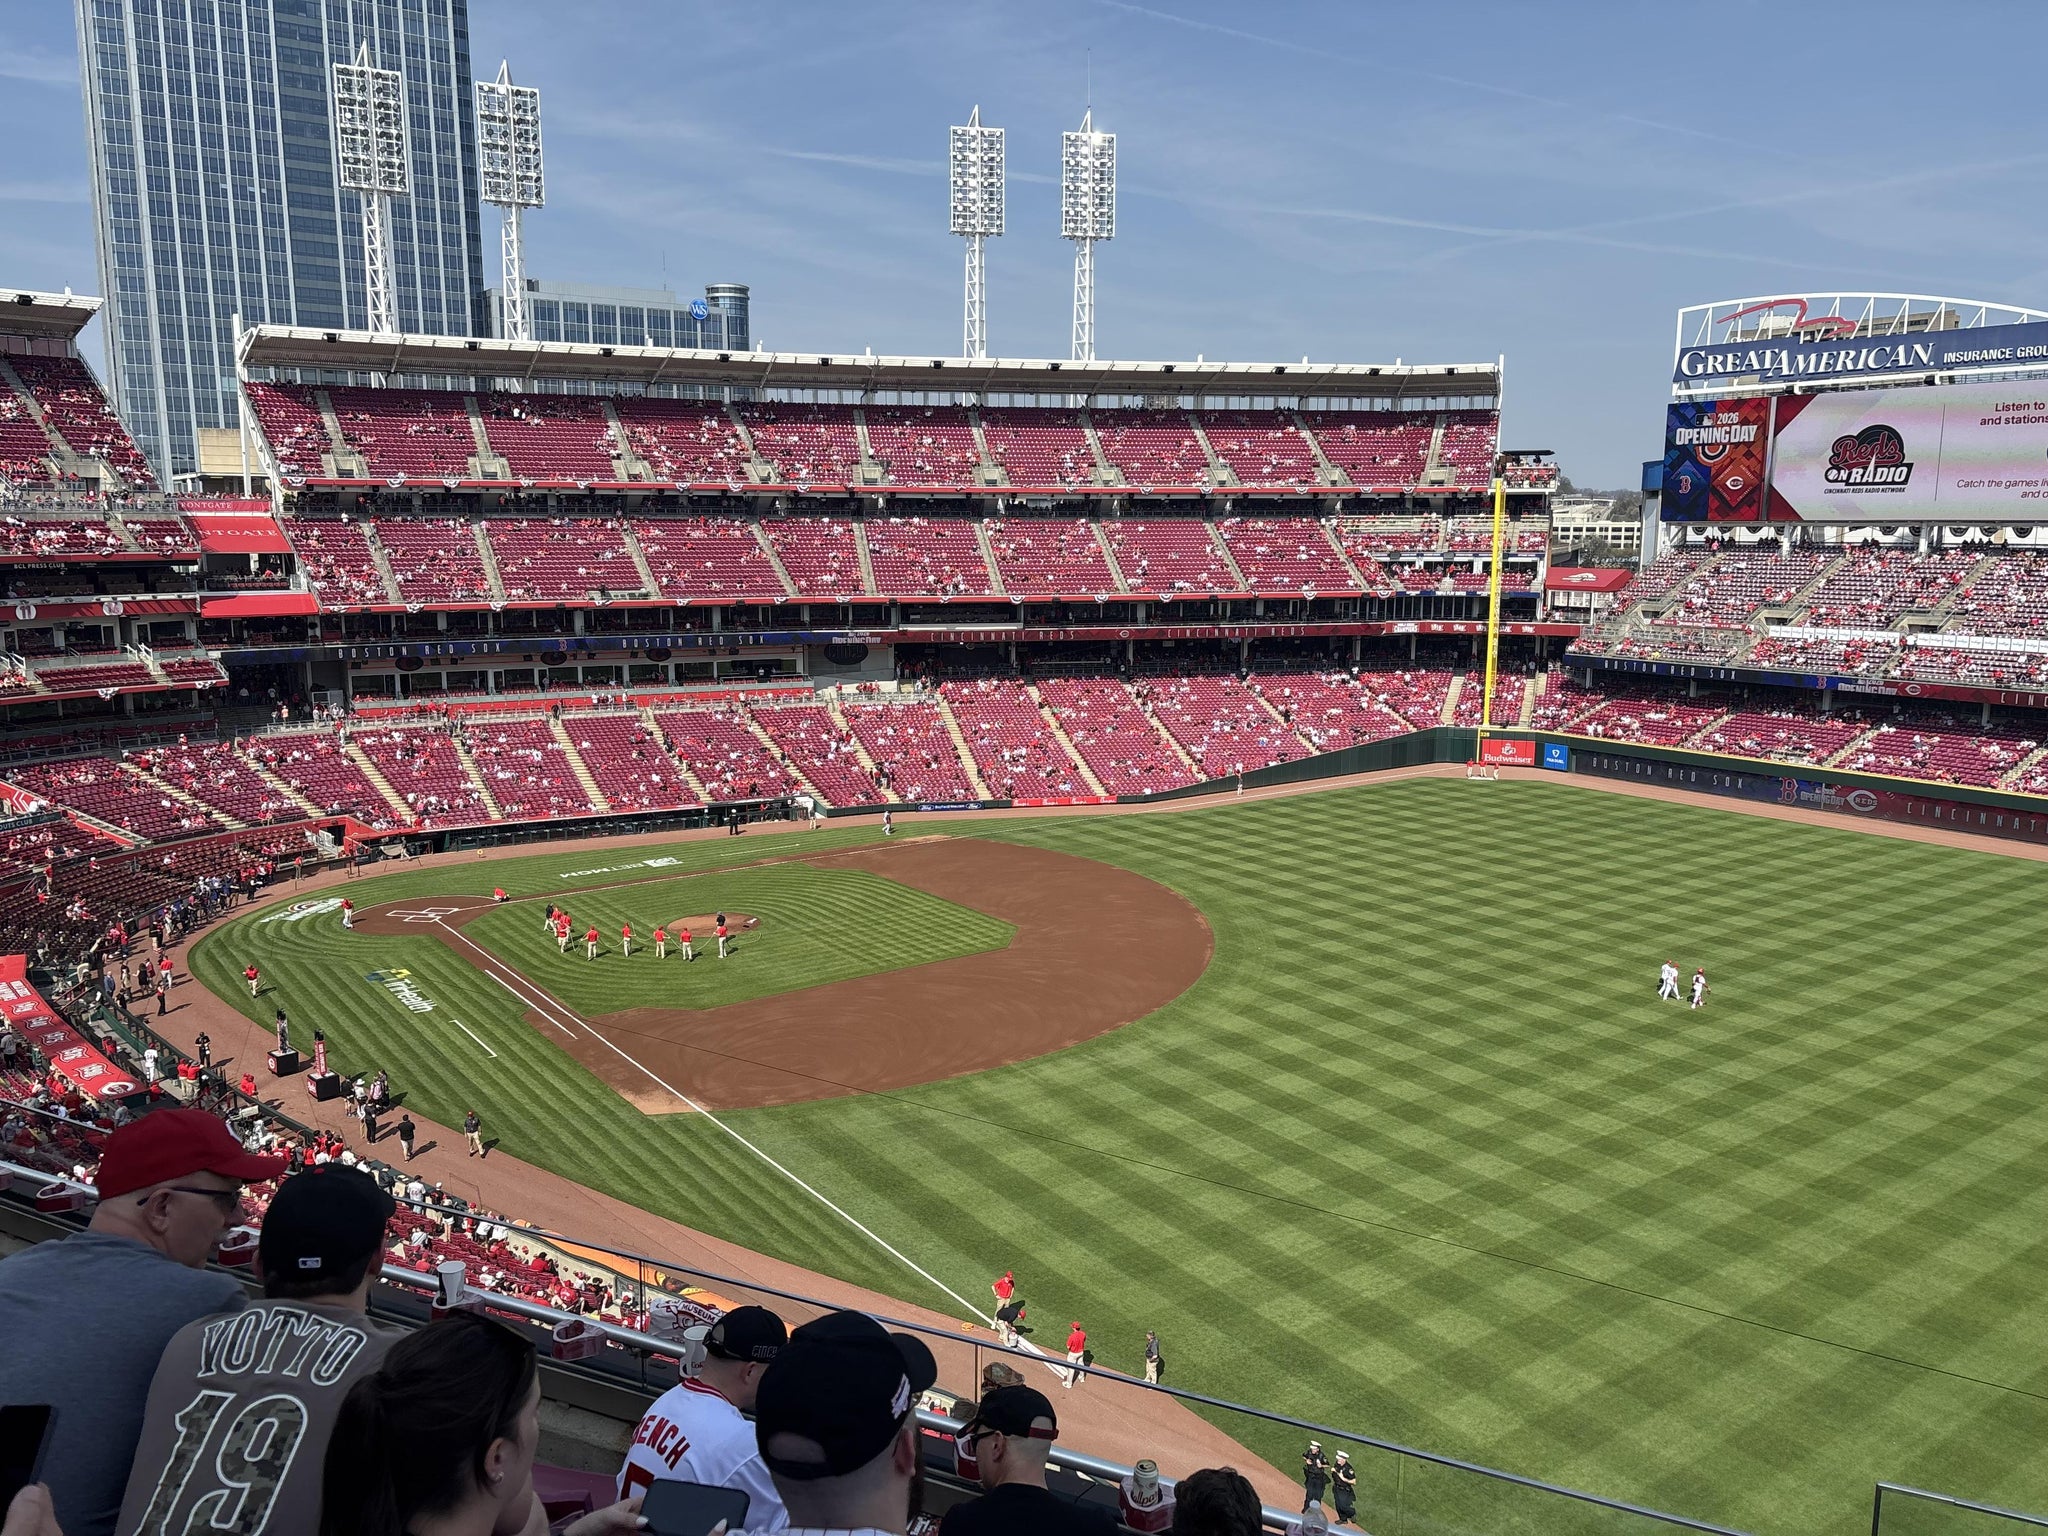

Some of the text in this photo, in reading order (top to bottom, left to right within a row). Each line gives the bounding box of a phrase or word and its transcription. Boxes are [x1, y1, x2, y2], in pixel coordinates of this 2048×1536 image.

[1681, 349, 1778, 377] GREAT
[1943, 348, 2014, 364] INSURANCE
[1995, 401, 2045, 412] Listen to
[1717, 412, 1739, 424] 2026
[1980, 416, 2001, 426] and
[1675, 425, 1758, 445] OPENING DAY
[1831, 431, 1902, 466] Reds
[1849, 461, 1908, 483] RADIO
[1957, 479, 1985, 488] Catch
[1987, 479, 2003, 488] the
[2004, 480, 2038, 489] games
[2021, 490, 2040, 499] and
[931, 631, 1075, 641] CINCINNATI REDS
[1168, 627, 1304, 638] CINCINNATI REDS
[622, 634, 764, 649] BOSTON RED SOX
[338, 642, 500, 659] BOSTON RED SOX
[1604, 659, 1736, 680] BOSTON RED SOX
[1484, 753, 1532, 764] Budweiser
[1592, 757, 1743, 789] BOSTON RED SOX
[682, 1303, 716, 1323] MUSEUM
[197, 1307, 367, 1386] VOTTO
[133, 1389, 309, 1536] 19
